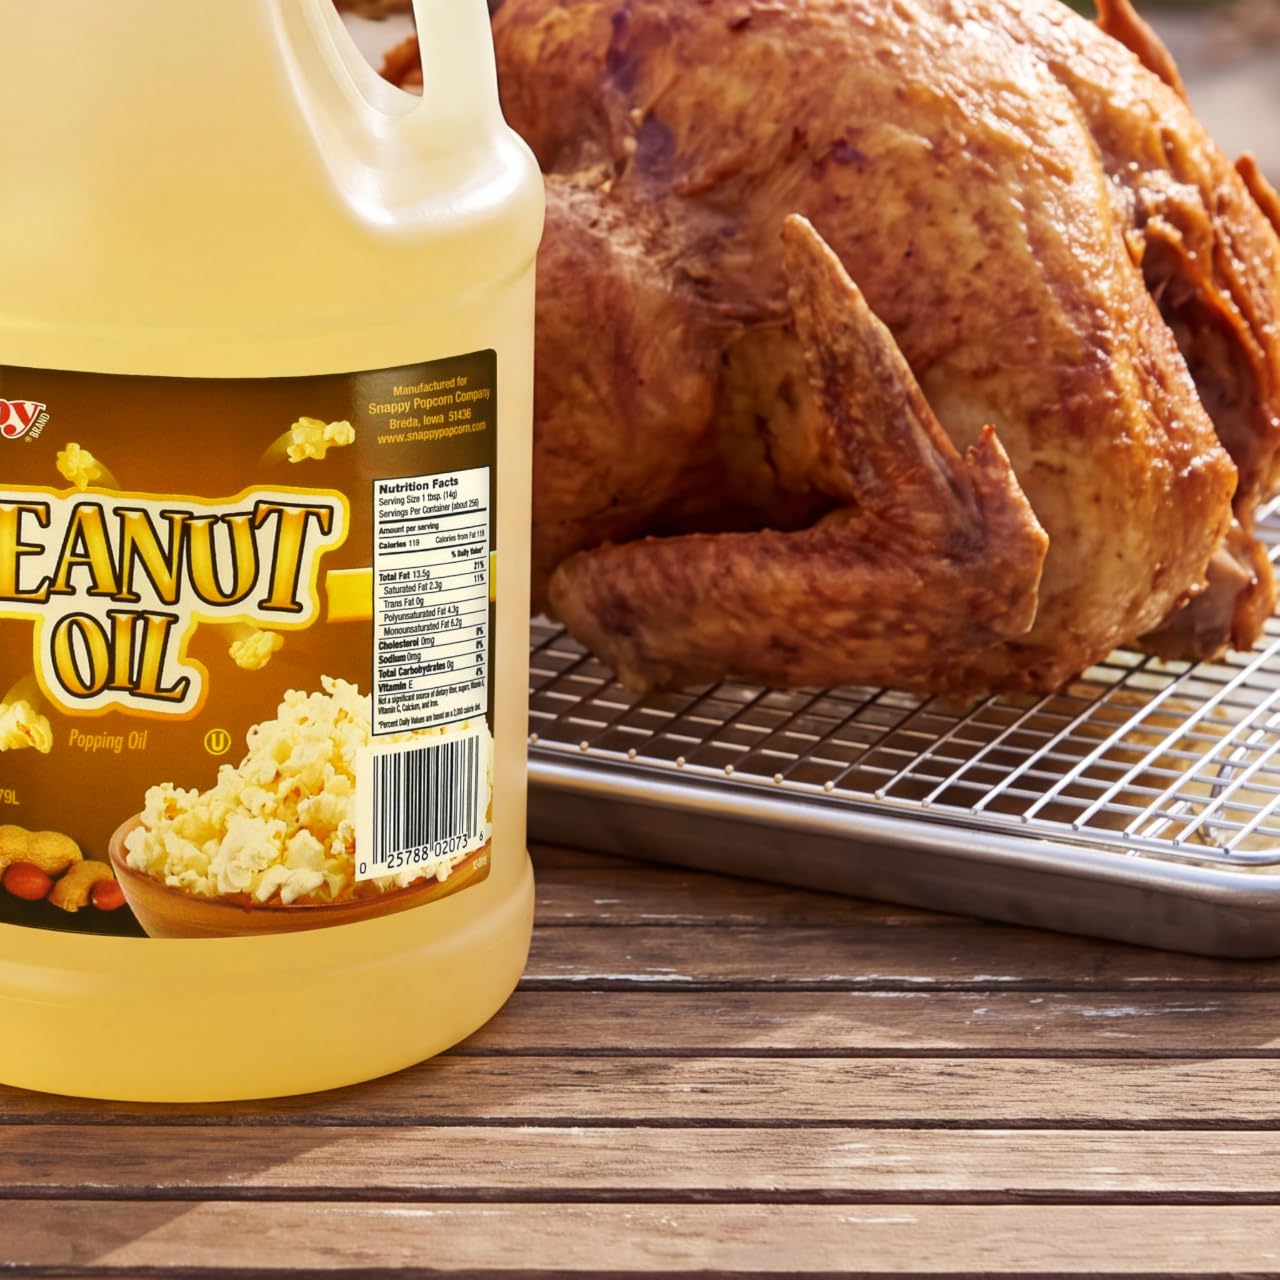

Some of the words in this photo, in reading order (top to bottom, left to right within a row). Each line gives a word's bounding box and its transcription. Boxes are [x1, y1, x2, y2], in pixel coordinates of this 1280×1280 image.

[394, 377, 455, 396] Manufactured
[457, 376, 468, 386] for
[369, 401, 410, 414] Snappy
[414, 395, 453, 409] Popcorn
[456, 388, 490, 402] Company
[29, 412, 50, 438] BRAND
[390, 417, 420, 429] Breda,
[424, 414, 444, 425] Iowa
[449, 408, 471, 421] 51436
[378, 421, 486, 444] www.snappypopcorn.com
[379, 482, 429, 494] Nutrition
[433, 477, 458, 489] Facts
[379, 497, 404, 506] Serving
[407, 495, 419, 503] Size
[428, 492, 441, 501] tbsp.
[443, 490, 457, 500] (14g)
[379, 509, 408, 518] Servings
[410, 507, 421, 515] Per
[423, 504, 450, 514] Container
[452, 500, 468, 511] (about
[379, 526, 404, 535] Amount
[417, 522, 439, 531] serving
[379, 541, 406, 549] Calories
[436, 534, 456, 543] Calories
[458, 548, 469, 558] Daily
[474, 560, 484, 569] 21%
[379, 573, 396, 581] Total
[399, 571, 410, 579] Fat
[413, 569, 430, 579] 13.5g
[474, 574, 484, 583] 11%
[384, 584, 416, 595] Saturated
[418, 583, 428, 591] Fat
[429, 581, 442, 591] 2.3g
[384, 599, 402, 608] Trans
[404, 598, 414, 606] Fat
[416, 597, 424, 606] 0g
[384, 608, 435, 624] Polyunsaturated
[448, 605, 459, 615] 4.3g
[384, 621, 439, 636] Monounsaturated
[441, 620, 449, 628] Fat
[451, 618, 462, 628] 6.2g
[379, 637, 419, 650] Cholesterol
[421, 636, 435, 647] 0mg
[51, 609, 191, 704] OIL
[379, 655, 406, 664] Sodium
[407, 652, 421, 663] 0mg
[379, 669, 396, 678] Total
[398, 663, 445, 676] Carbohydrates
[447, 660, 454, 671] 0g
[378, 682, 406, 692] Vitamin
[409, 680, 413, 689] E
[378, 705, 395, 715] Vitamin
[399, 718, 410, 726] Daily
[69, 729, 122, 752] Popping
[128, 730, 147, 749] Oil
[360, 862, 366, 874] 0
[387, 846, 428, 869] 25788
[434, 834, 468, 857] 02073
[479, 831, 483, 841] 6
